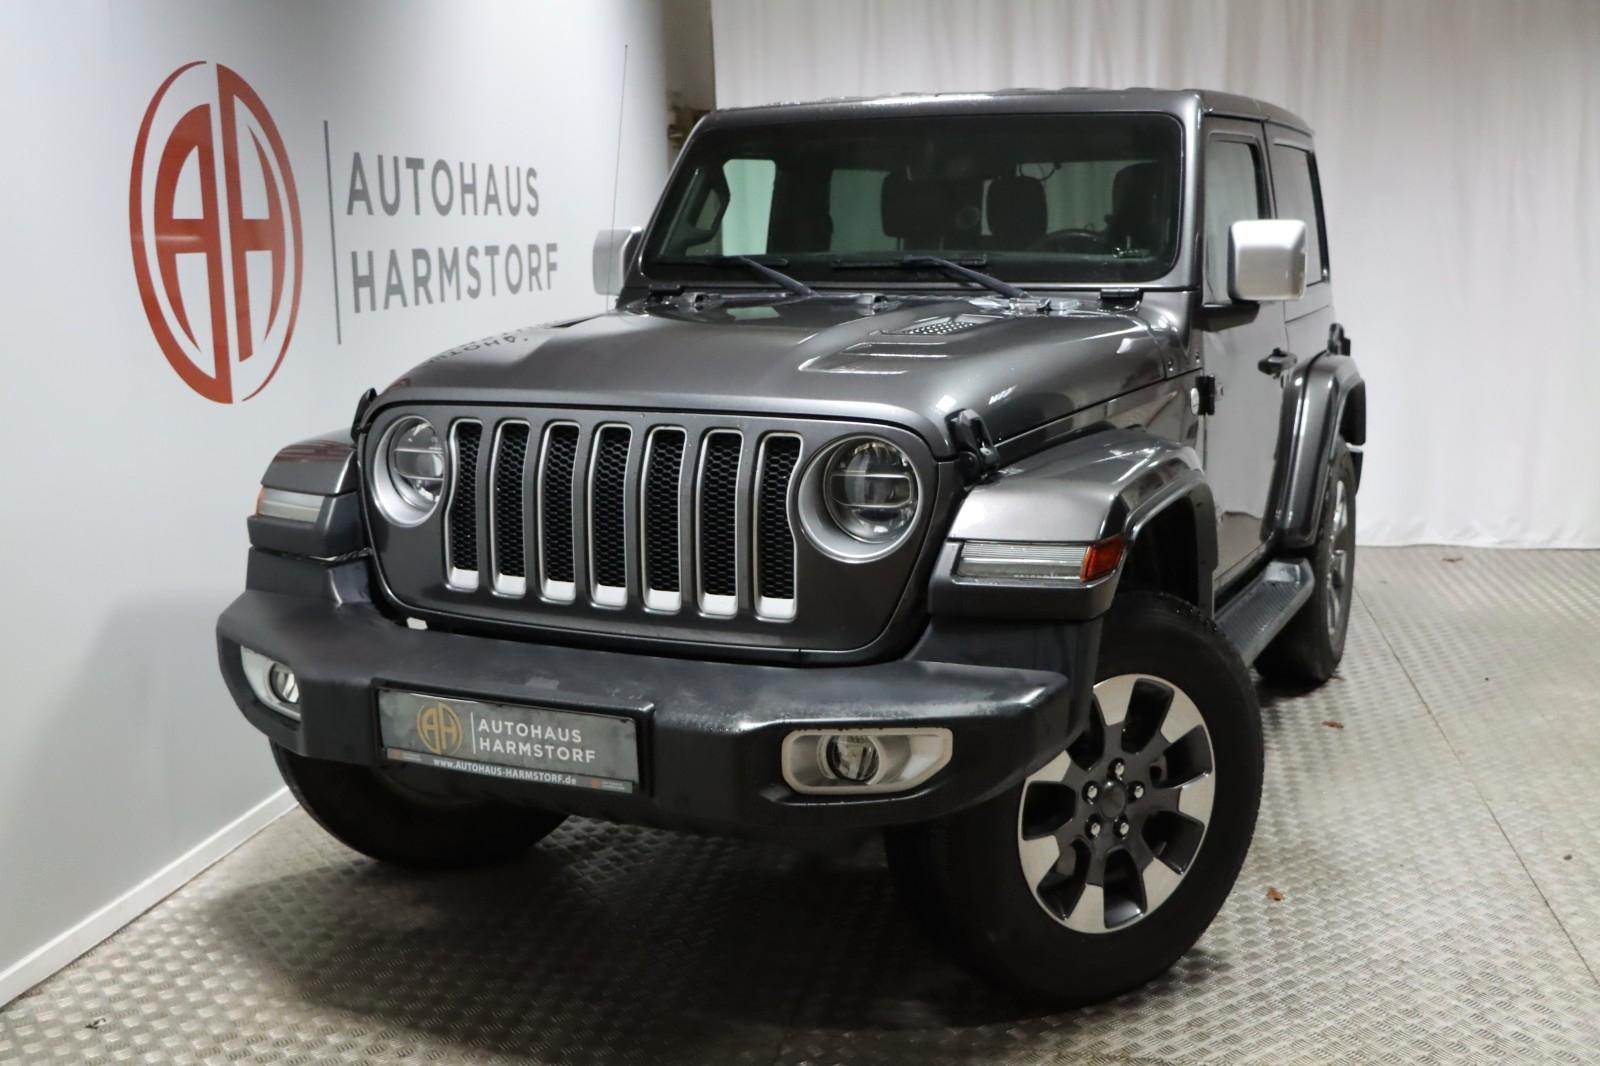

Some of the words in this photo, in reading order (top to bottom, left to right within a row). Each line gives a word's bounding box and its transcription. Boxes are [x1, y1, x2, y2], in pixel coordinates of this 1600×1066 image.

[347, 152, 540, 216] AUTOHAUS
[351, 243, 559, 313] HARMSTORF
[477, 718, 582, 743] AUTOHAUS
[479, 737, 596, 764] HARMSTORF
[433, 758, 577, 785] www.AUTOHAUS-HARMSTORF.de
